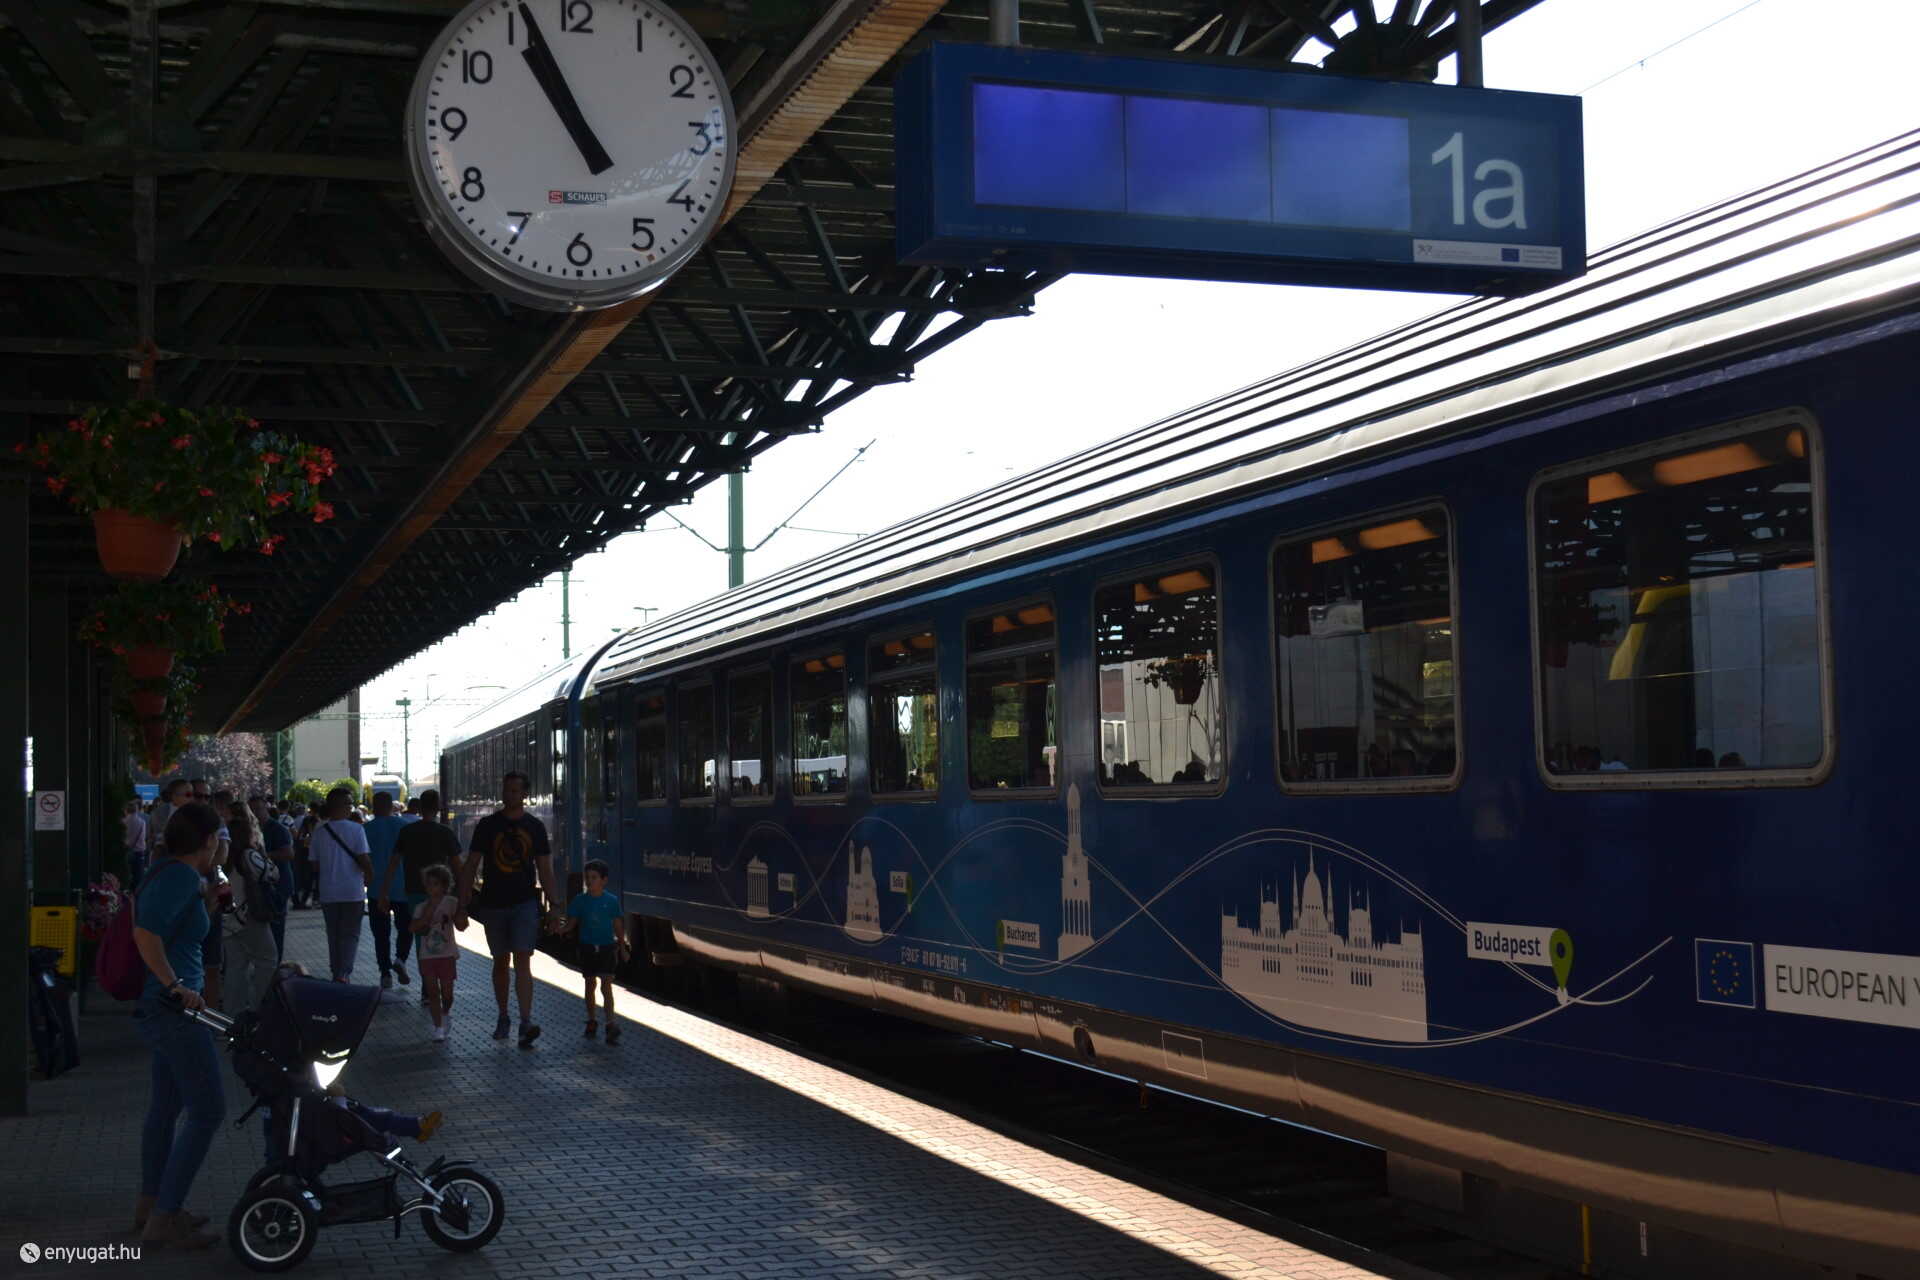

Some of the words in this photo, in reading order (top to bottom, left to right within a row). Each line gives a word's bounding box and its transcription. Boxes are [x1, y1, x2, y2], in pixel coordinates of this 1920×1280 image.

[561, 0, 594, 33] 12
[636, 19, 643, 52] 1
[463, 50, 493, 84] 10
[669, 65, 695, 99] 2
[440, 107, 467, 141] 9
[688, 122, 712, 156] 3
[460, 167, 485, 202] 8
[667, 179, 692, 213] 4
[1431, 131, 1528, 230] 1a
[506, 211, 533, 246] 7
[631, 217, 655, 251] 5
[566, 232, 593, 267] 6
[1006, 925, 1037, 943] Bucharest
[1474, 930, 1541, 960] Budapest
[1776, 964, 1907, 1007] EUROPEAN
